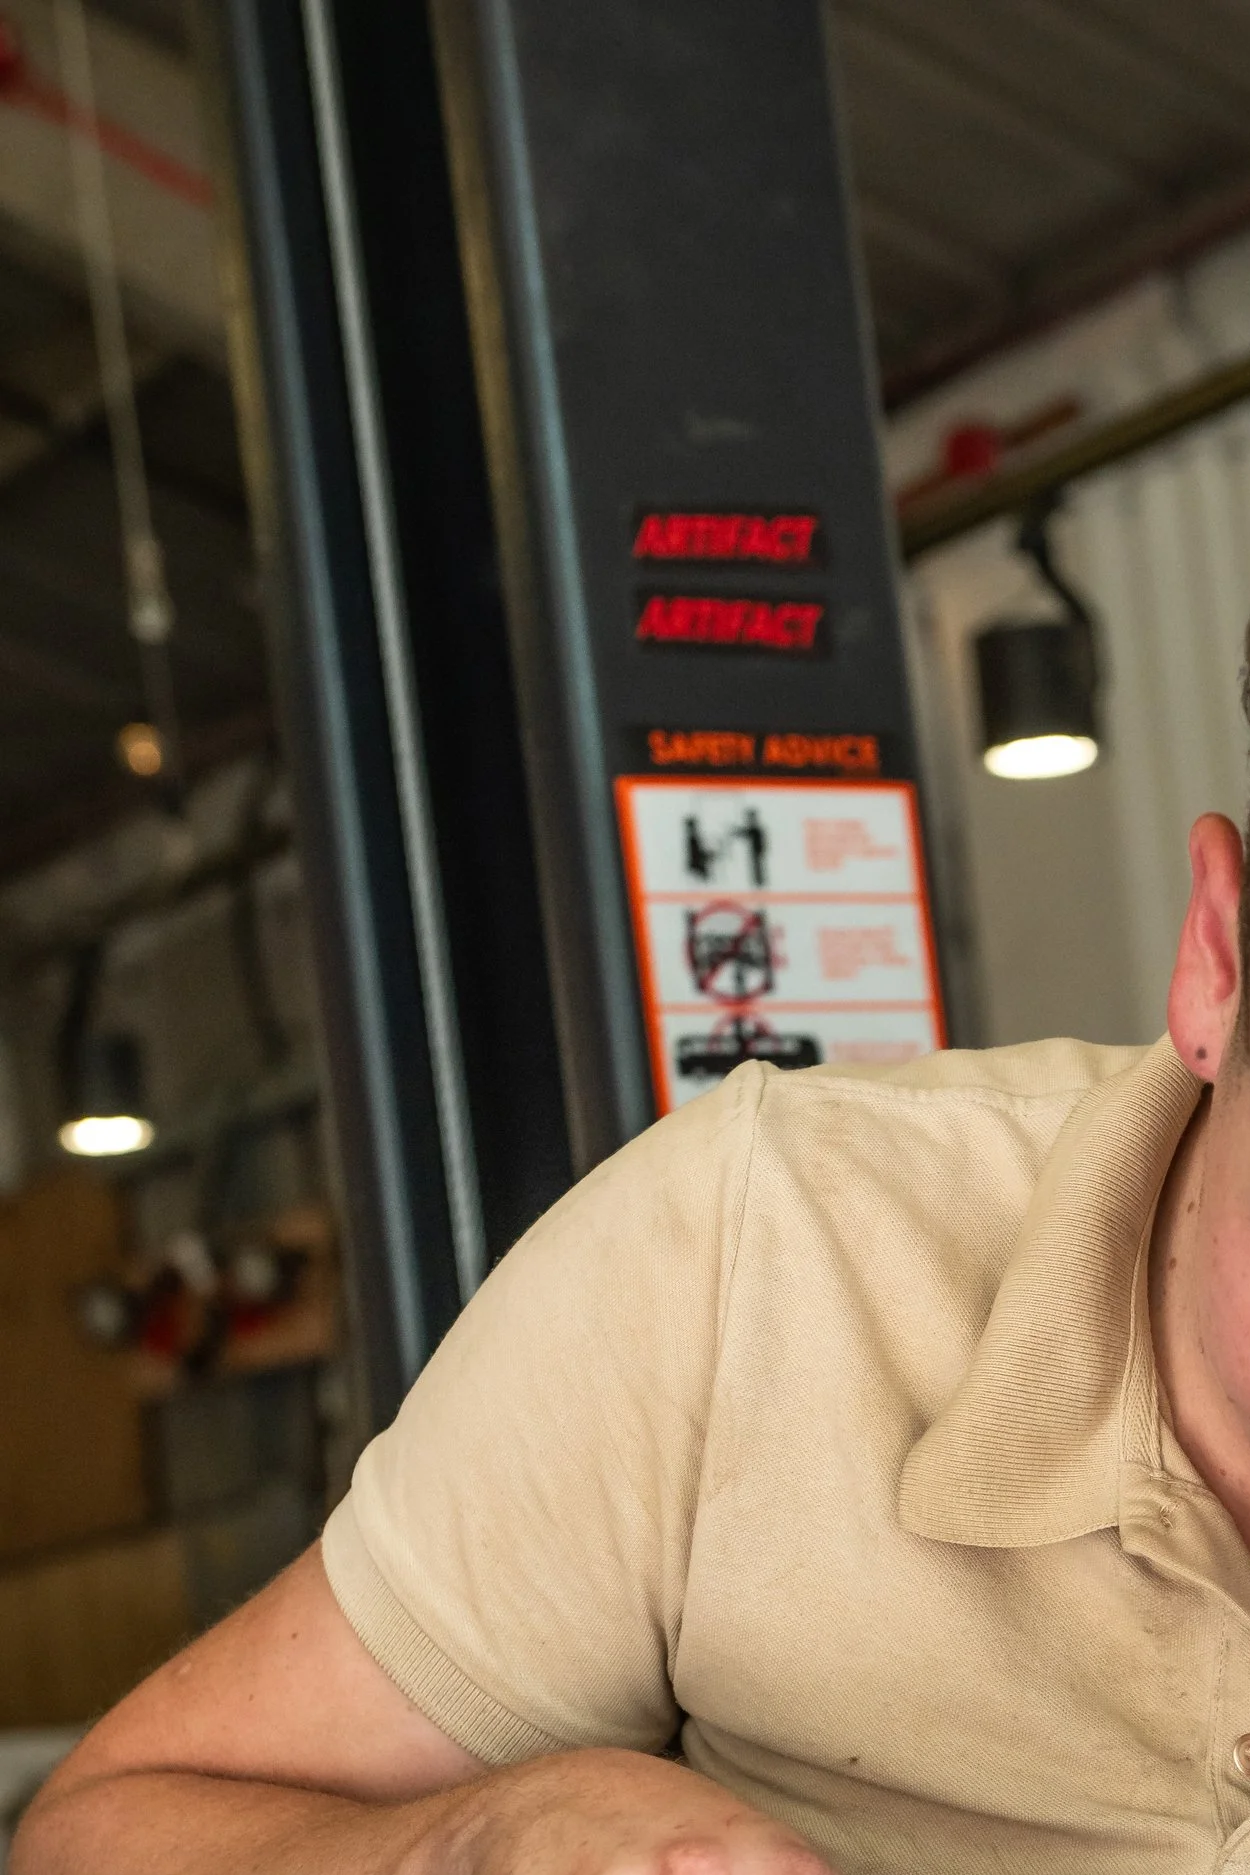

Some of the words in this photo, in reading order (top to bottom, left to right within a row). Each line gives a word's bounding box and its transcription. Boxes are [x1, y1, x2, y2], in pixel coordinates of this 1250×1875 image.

[634, 514, 817, 561] ARTIFACT
[636, 595, 823, 648] ARTIFACT
[648, 730, 755, 766] SAFETY
[763, 734, 879, 769] ADVICE
